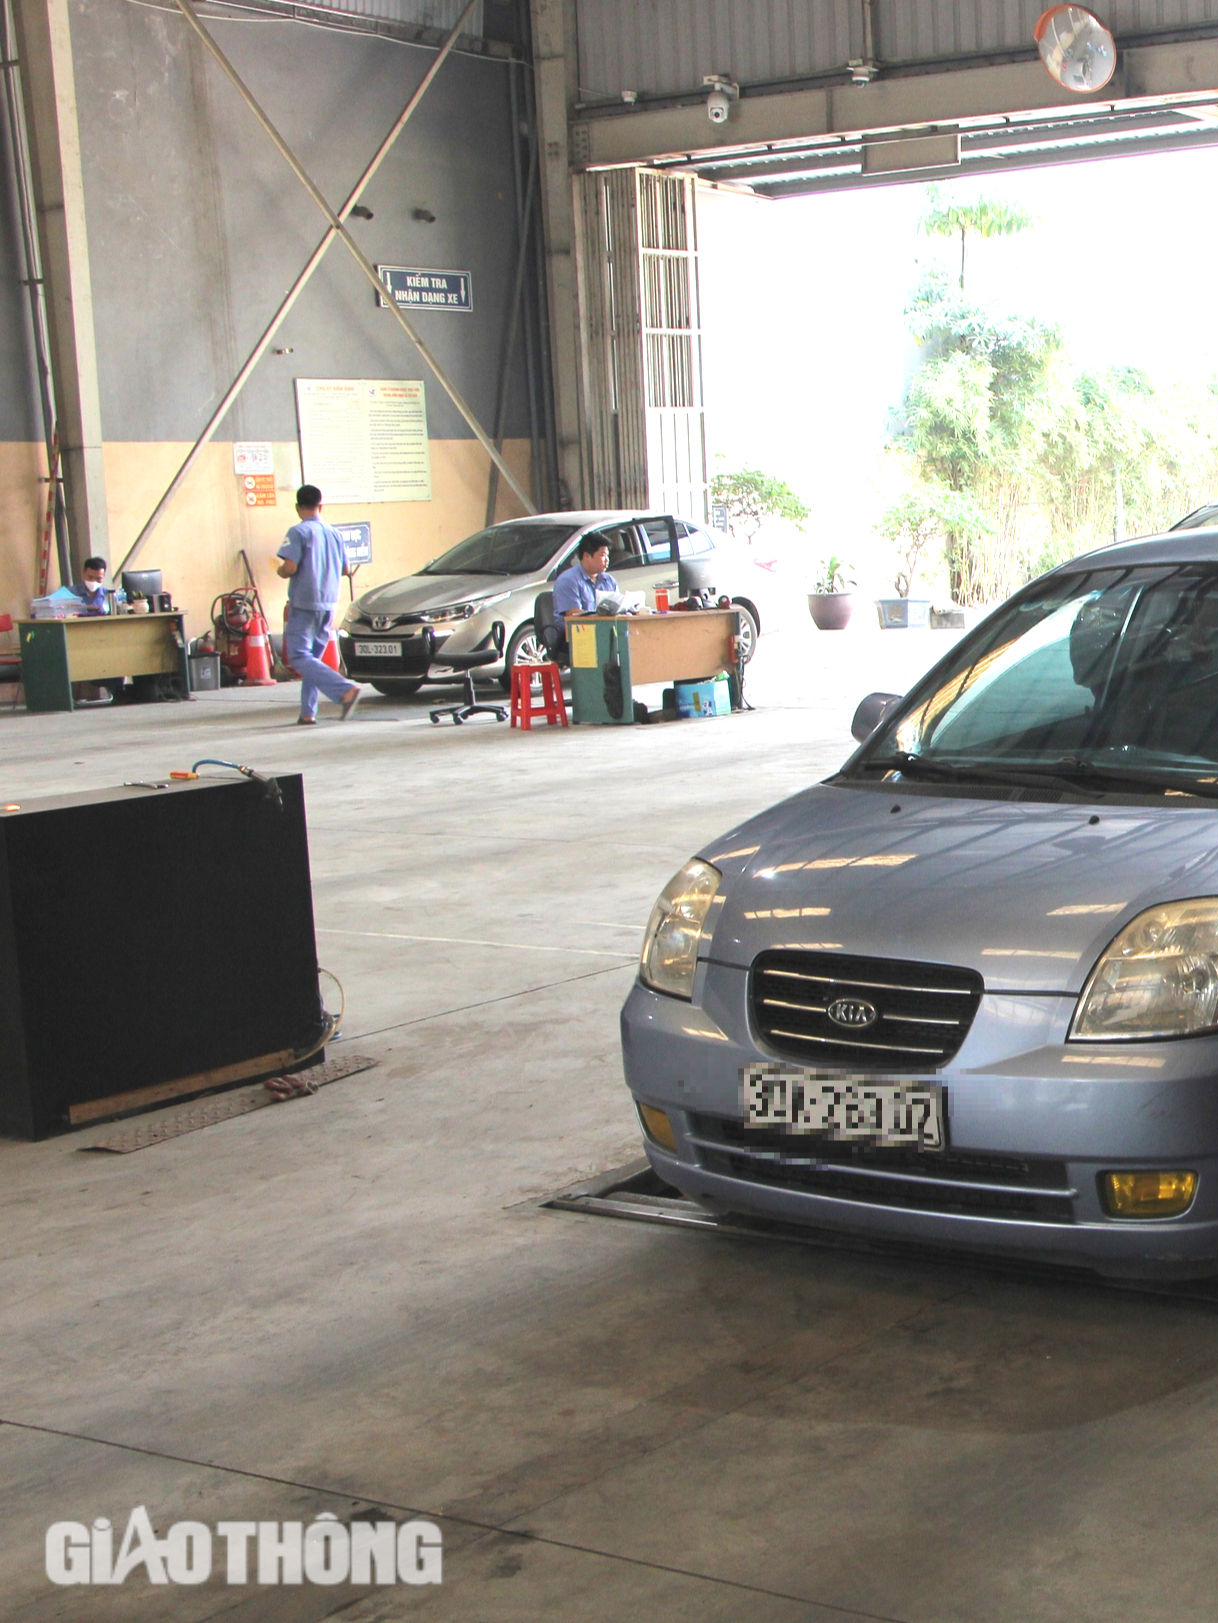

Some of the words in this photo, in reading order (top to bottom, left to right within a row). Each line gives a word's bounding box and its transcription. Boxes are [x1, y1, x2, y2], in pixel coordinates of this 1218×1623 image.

[406, 272, 429, 288] KIỂM
[431, 278, 447, 289] TRA
[395, 289, 419, 303] NHẬN
[422, 292, 445, 304] DẠNG
[447, 293, 458, 304] XE
[836, 1003, 867, 1022] KIA
